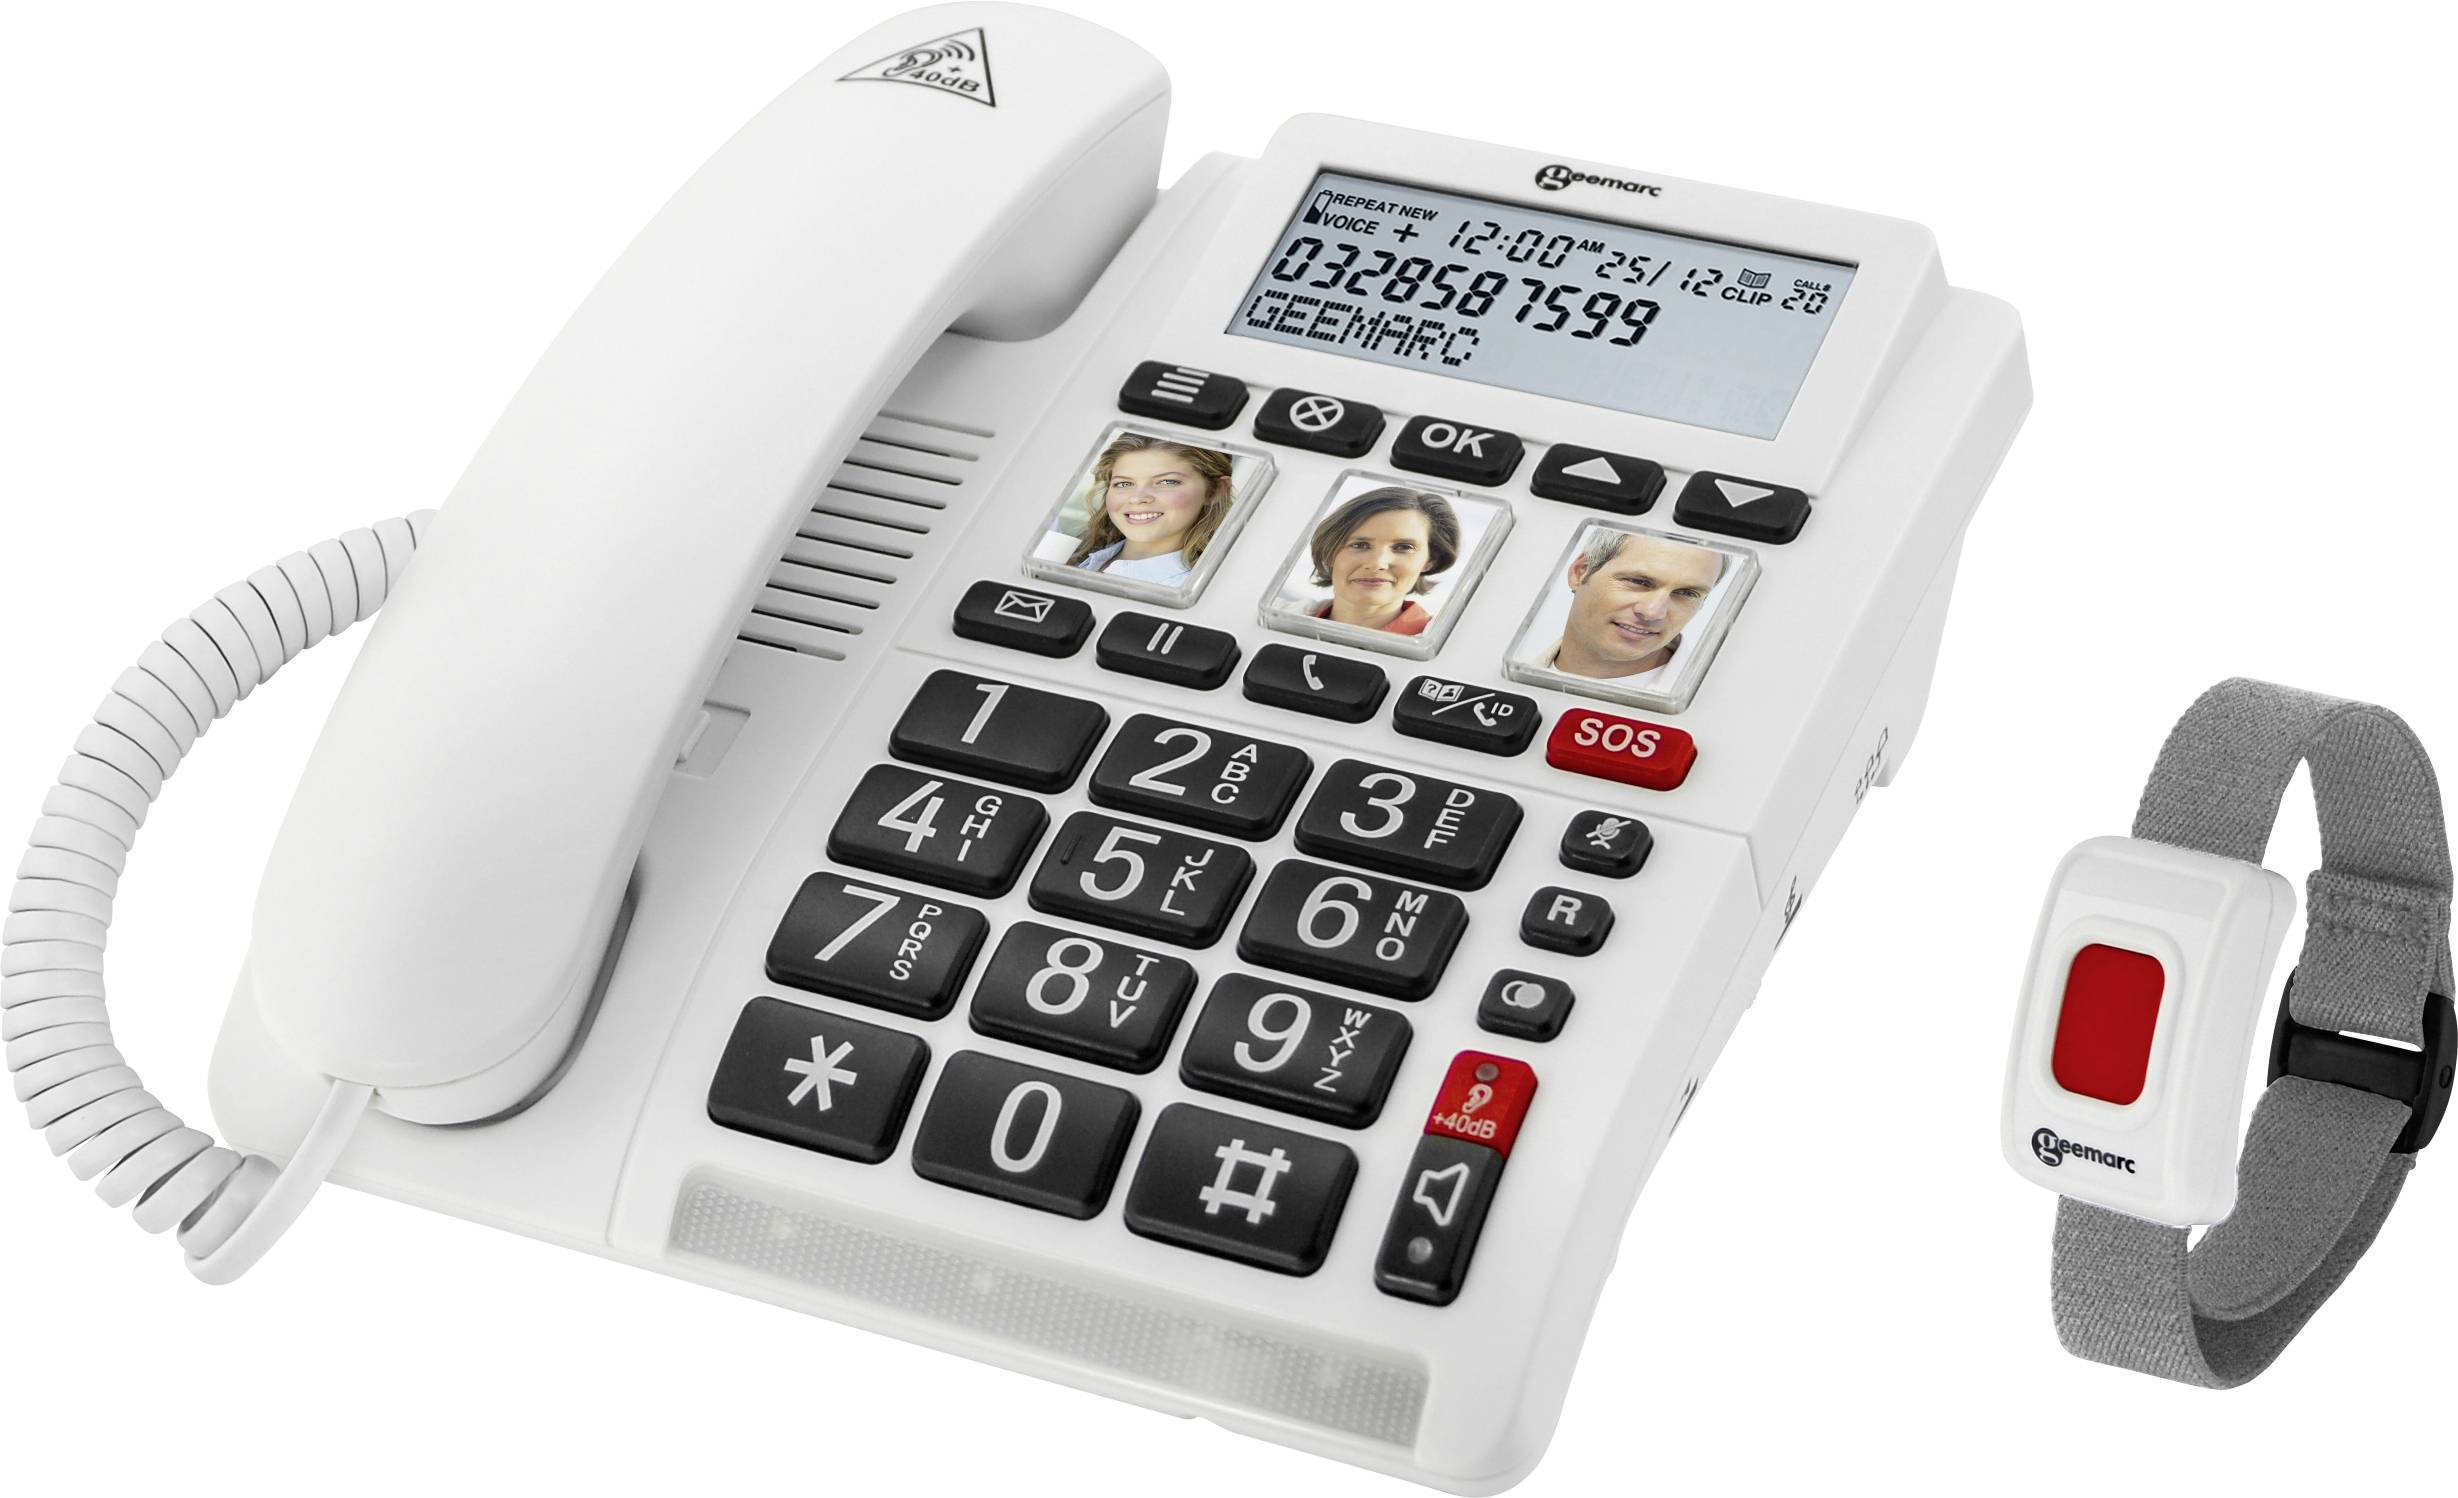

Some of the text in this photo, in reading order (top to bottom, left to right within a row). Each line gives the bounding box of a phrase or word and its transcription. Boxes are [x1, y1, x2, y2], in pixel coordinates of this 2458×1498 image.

[909, 69, 981, 93] 40dB
[1534, 164, 1662, 198] geemarc
[1322, 212, 1380, 235] VOICE
[1332, 193, 1439, 222] REPEAT NEW
[1449, 220, 1576, 269] 12:00
[1576, 238, 1606, 254] AM
[1271, 236, 1661, 347] 0328587599
[1720, 286, 1773, 306] CLIP
[1780, 287, 1829, 315] 20
[1246, 289, 1480, 367] GEEMARC
[1421, 422, 1495, 459] OK
[954, 684, 1010, 745] 1
[1491, 702, 1514, 717] ID
[1129, 727, 1212, 797] 2
[1574, 717, 1662, 759] SOS
[876, 780, 946, 853] 4
[1339, 772, 1417, 840] 3
[1078, 832, 1162, 902] 5
[813, 884, 901, 963] 7
[1295, 876, 1374, 950] 6
[1547, 895, 1583, 926] R
[1025, 936, 1103, 1016] 8
[1233, 993, 1310, 1073] 9
[990, 1080, 1064, 1173] 0
[1432, 1111, 1497, 1140] +40dB
[2031, 1127, 2136, 1175] geemarc
